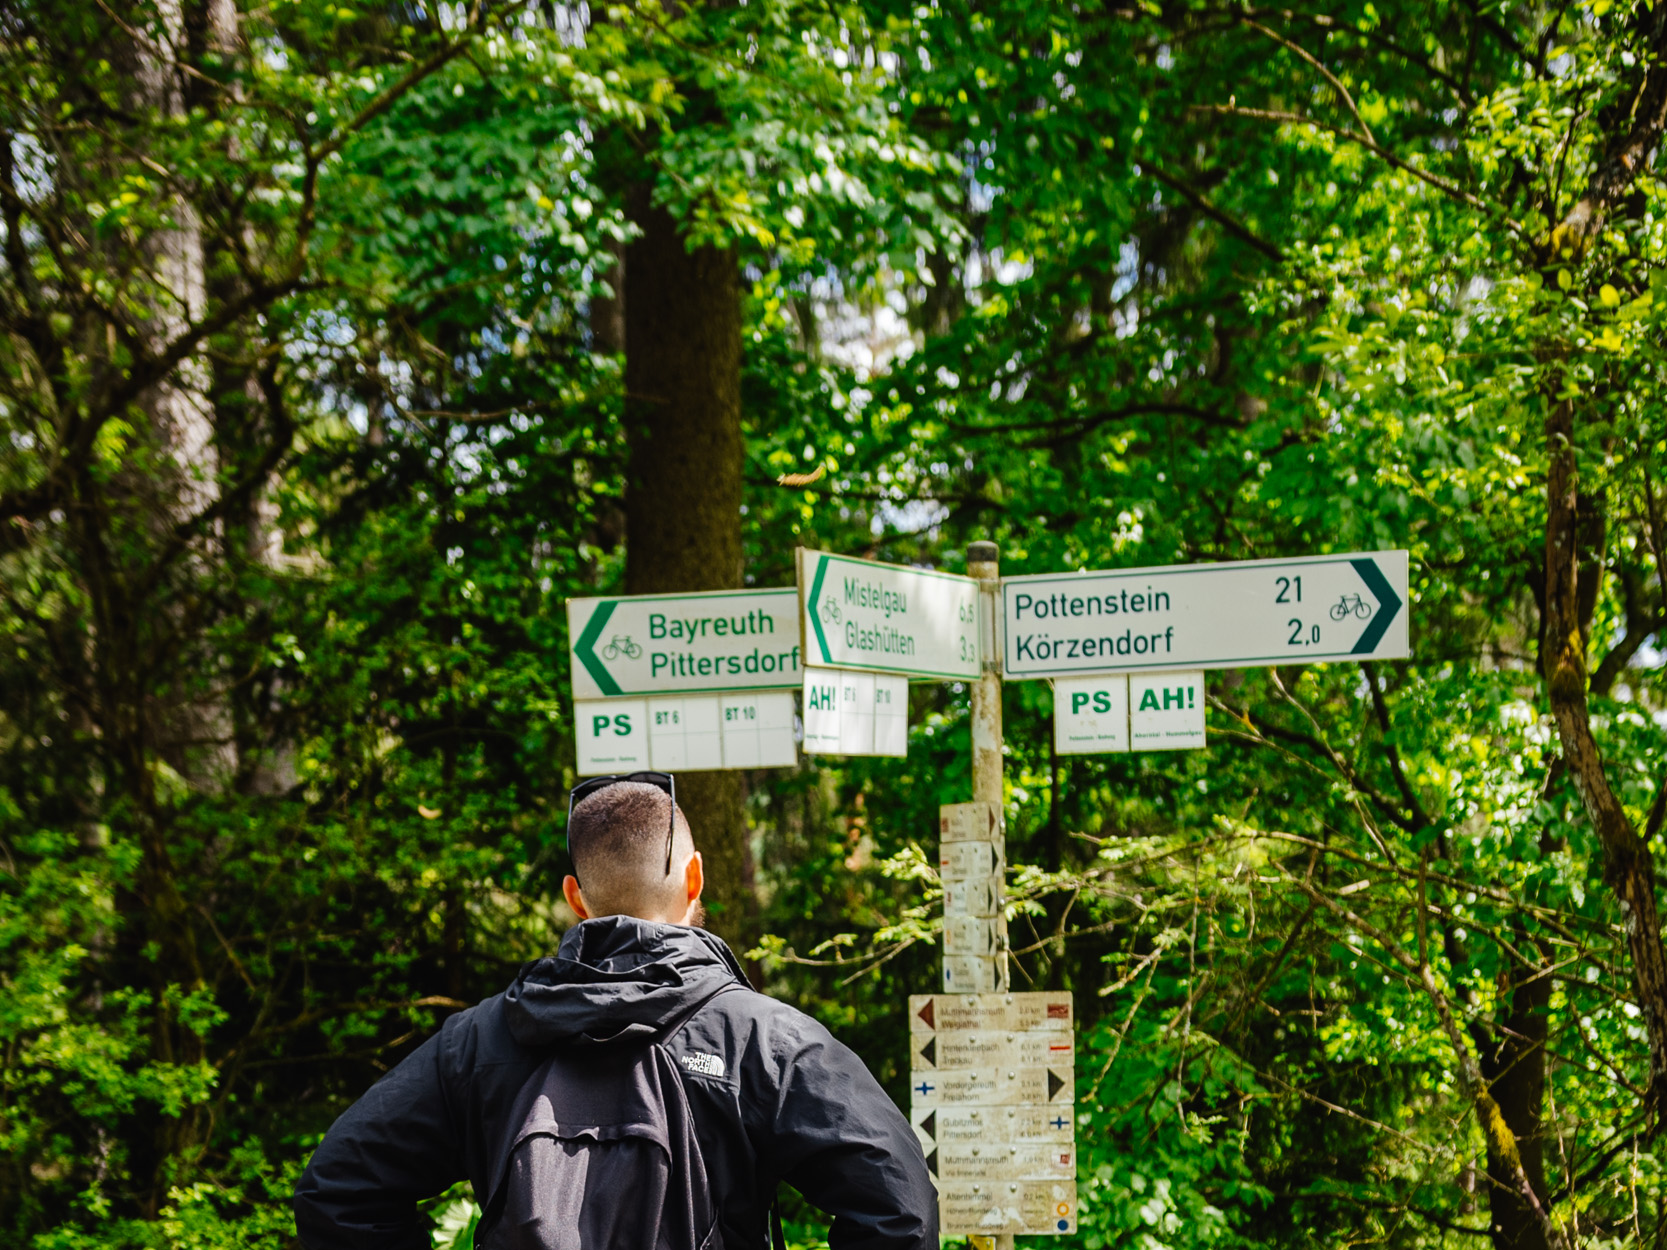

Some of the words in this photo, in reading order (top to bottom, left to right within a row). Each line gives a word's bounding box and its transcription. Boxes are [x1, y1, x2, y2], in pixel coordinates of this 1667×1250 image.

[844, 576, 907, 618] Mistelgau
[1015, 586, 1171, 620] Pottenstein
[1275, 576, 1302, 604] 21
[649, 608, 774, 644] Bayreuth
[845, 620, 915, 656] Glashütten
[1288, 619, 1320, 647] 2,0
[1016, 626, 1175, 661] Körzendorf
[651, 646, 801, 678] Pittersdorf
[808, 685, 837, 711] AH!
[1071, 690, 1112, 714] PS
[1138, 686, 1195, 712] AH!
[592, 714, 632, 737] PS
[654, 711, 670, 726] BT
[672, 710, 680, 725] 6
[725, 707, 740, 722] BT
[743, 705, 756, 720] 10
[681, 1055, 711, 1067] NORTH
[687, 1063, 711, 1075] FACE
[694, 1051, 712, 1062] THE
